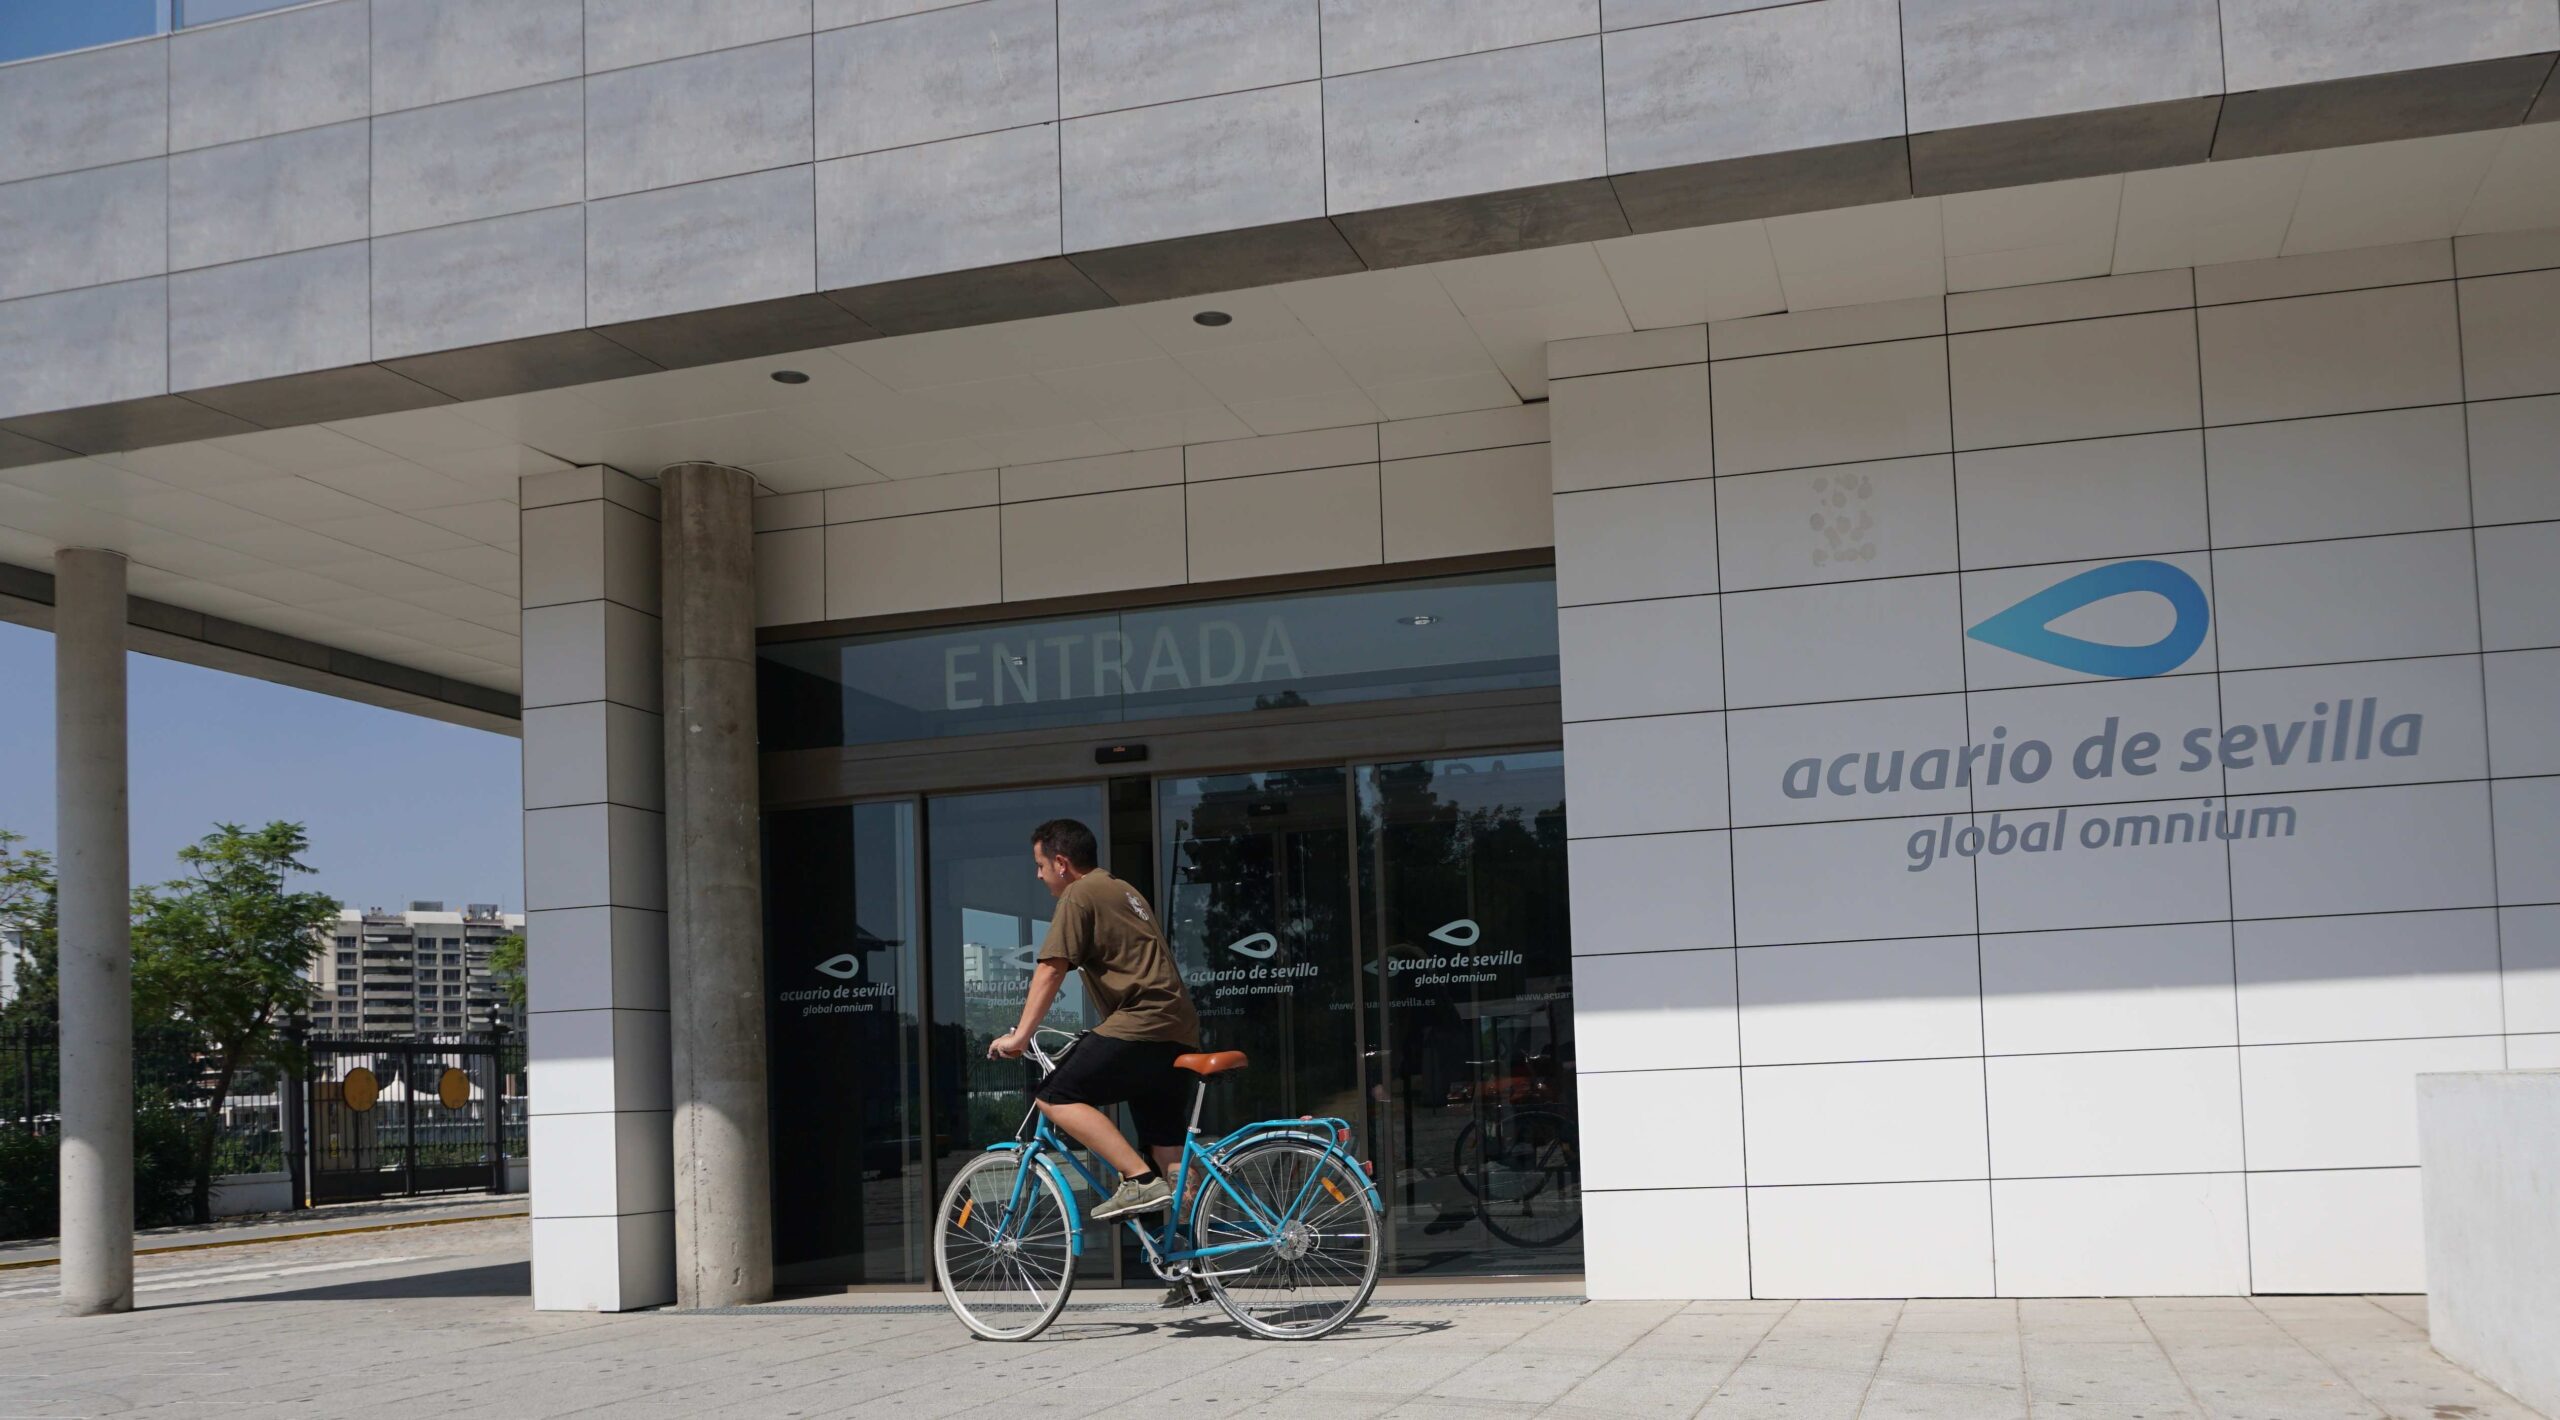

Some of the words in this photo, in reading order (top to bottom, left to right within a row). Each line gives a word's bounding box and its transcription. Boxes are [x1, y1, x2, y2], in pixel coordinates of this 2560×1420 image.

[946, 616, 1303, 710] ENTRADA
[1781, 726, 2053, 799] acuario
[2072, 716, 2161, 778] de
[2179, 697, 2424, 772] sevilla
[1906, 809, 2067, 872] global
[2079, 797, 2297, 849] omnium
[1388, 954, 1447, 972] acuario
[1450, 953, 1469, 969] de
[1472, 950, 1523, 966] sevilla
[1190, 966, 1246, 982] acuario
[1249, 965, 1267, 979] de
[1269, 962, 1319, 978] sevilla
[1414, 972, 1450, 988] global
[1451, 970, 1497, 982] omnium
[780, 986, 831, 1002] acuario
[833, 984, 850, 998] de
[852, 982, 896, 998] sevilla
[1215, 985, 1249, 999] global
[1250, 983, 1294, 995] omnium
[802, 1003, 833, 1017] global
[834, 1002, 873, 1013] omnium
